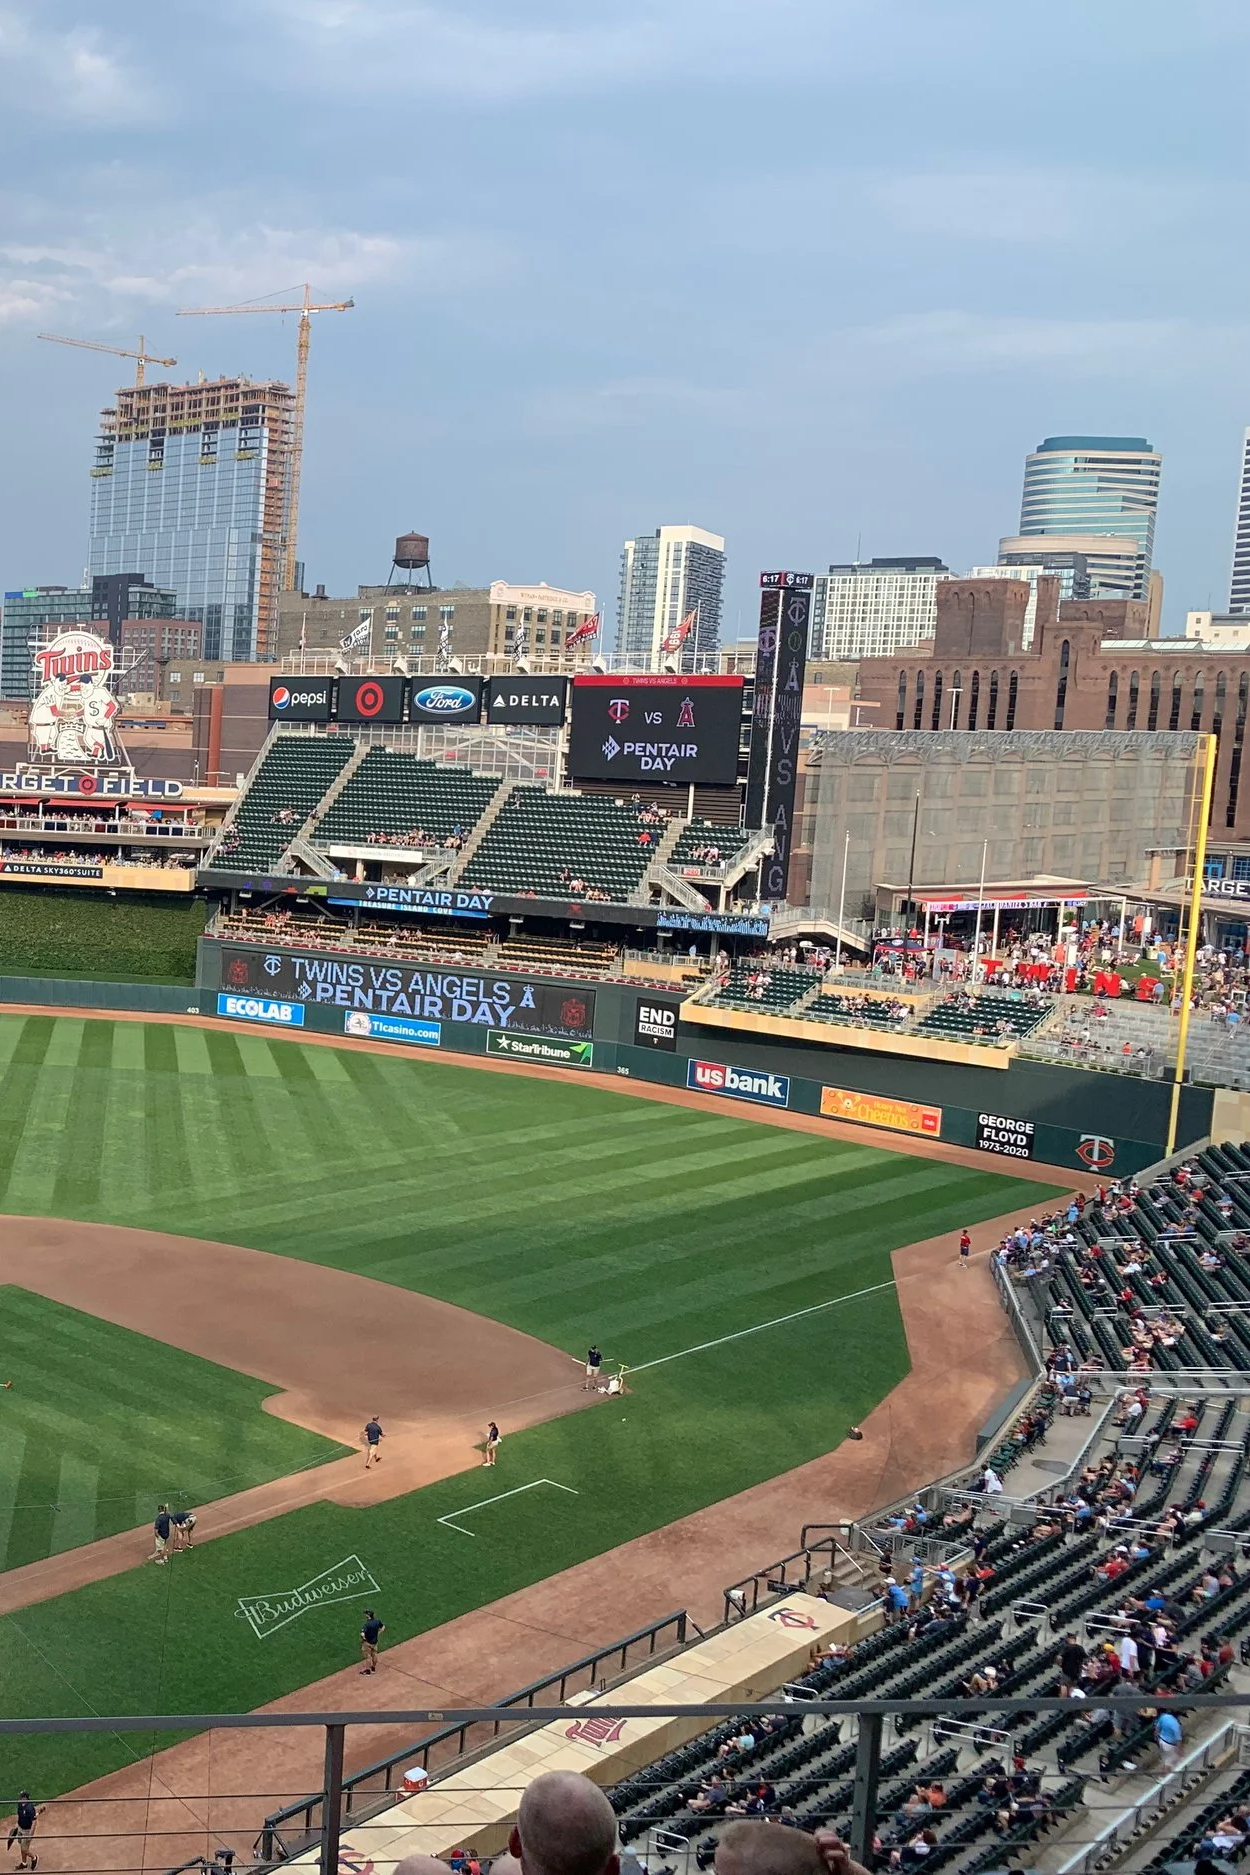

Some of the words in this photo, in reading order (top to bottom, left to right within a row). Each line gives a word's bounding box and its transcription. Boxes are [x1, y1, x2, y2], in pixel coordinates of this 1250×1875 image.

[762, 575, 779, 583] 6:17
[796, 576, 808, 584] 6:17
[35, 646, 112, 683] Twins
[291, 690, 327, 707] pepsi
[425, 689, 463, 709] Ford
[509, 694, 560, 707] DELTA
[644, 711, 663, 725] VS
[623, 742, 698, 758] PENTAIR
[640, 757, 676, 772] DAY
[103, 778, 183, 797] FIELD
[13, 865, 42, 873] DELTA
[1184, 878, 1250, 895] TRGE
[376, 887, 454, 908] PENTAIR
[456, 894, 494, 910] DAY
[359, 900, 396, 910] TREASURE
[400, 904, 429, 914] ISLAND
[432, 907, 453, 915] COVE
[291, 958, 364, 987] TWINS
[370, 968, 402, 991] VS
[408, 972, 510, 1004] ANGELS
[226, 997, 292, 1022] ECOLAB
[316, 983, 442, 1018] PENTAIR
[451, 1001, 516, 1028] DAY
[640, 1006, 676, 1026] END
[642, 1026, 674, 1036] RACISM
[617, 1066, 629, 1075] 365
[874, 1100, 893, 1110] Honey
[858, 1104, 909, 1128] Cheerios
[978, 1114, 1034, 1135] GEORGE
[983, 1127, 1027, 1146] FLOYD
[978, 1140, 1029, 1158] 1973-2020
[234, 1568, 371, 1625] Budweiser
